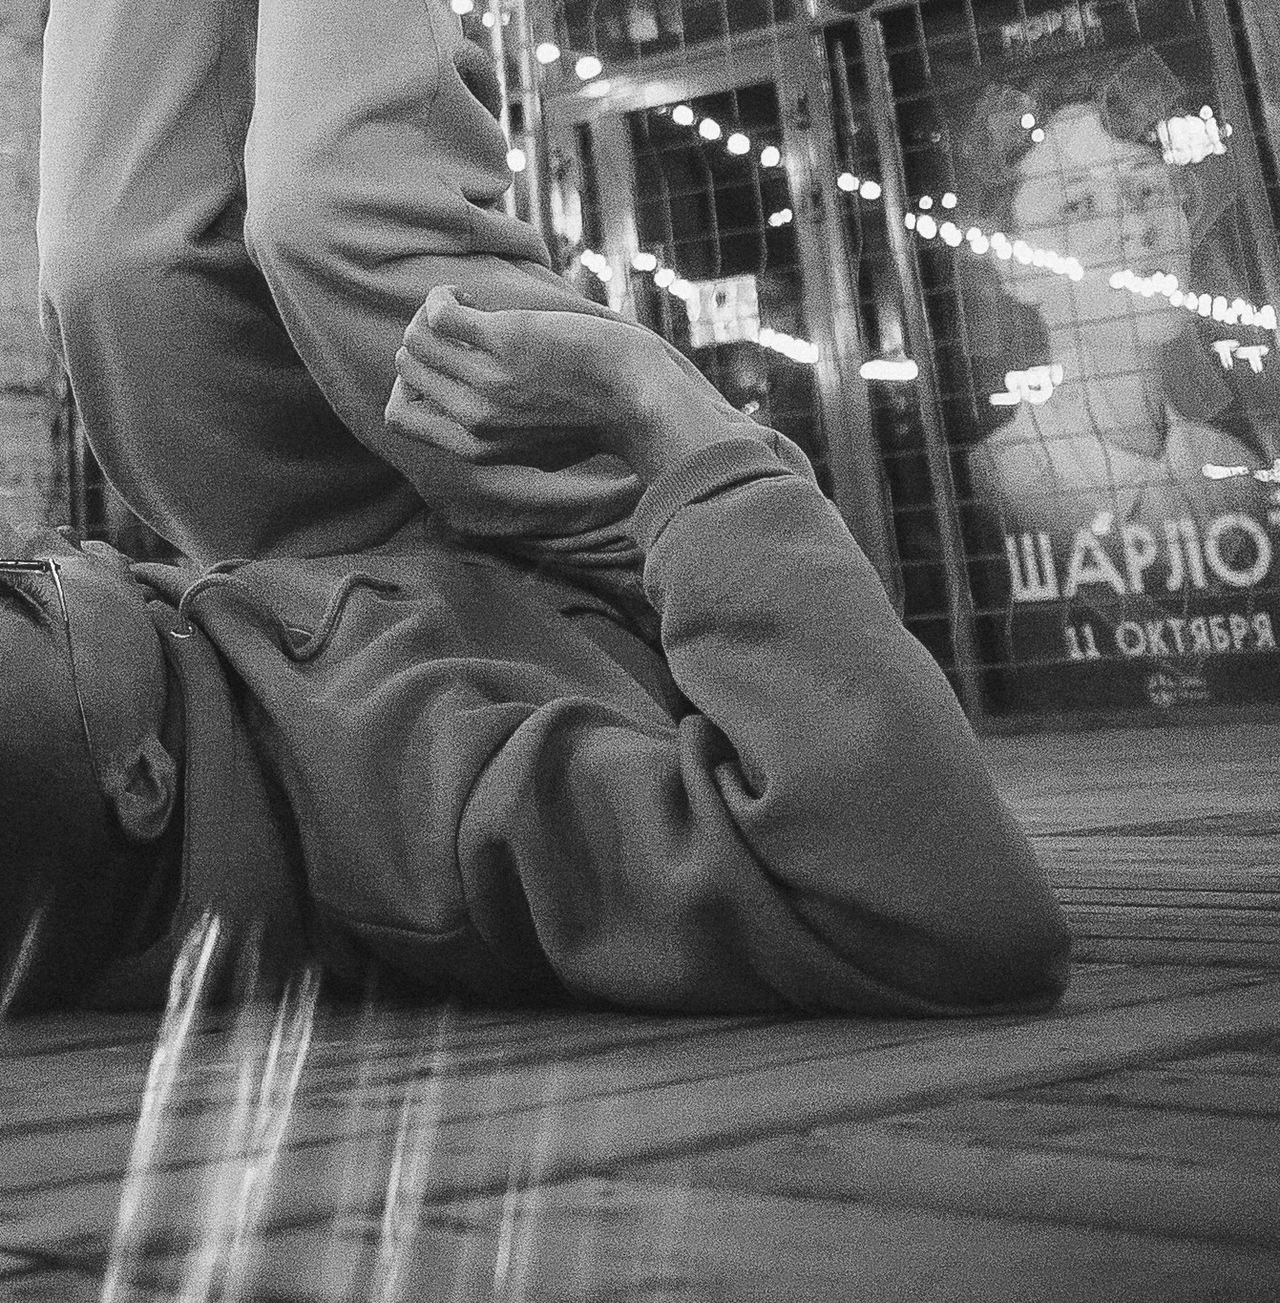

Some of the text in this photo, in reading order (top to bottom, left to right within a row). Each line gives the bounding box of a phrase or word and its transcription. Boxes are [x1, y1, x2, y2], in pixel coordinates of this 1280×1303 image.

[1004, 510, 1280, 603] ШАРЛО
[1065, 611, 1275, 661] 11 ОКТЯБРЯ
